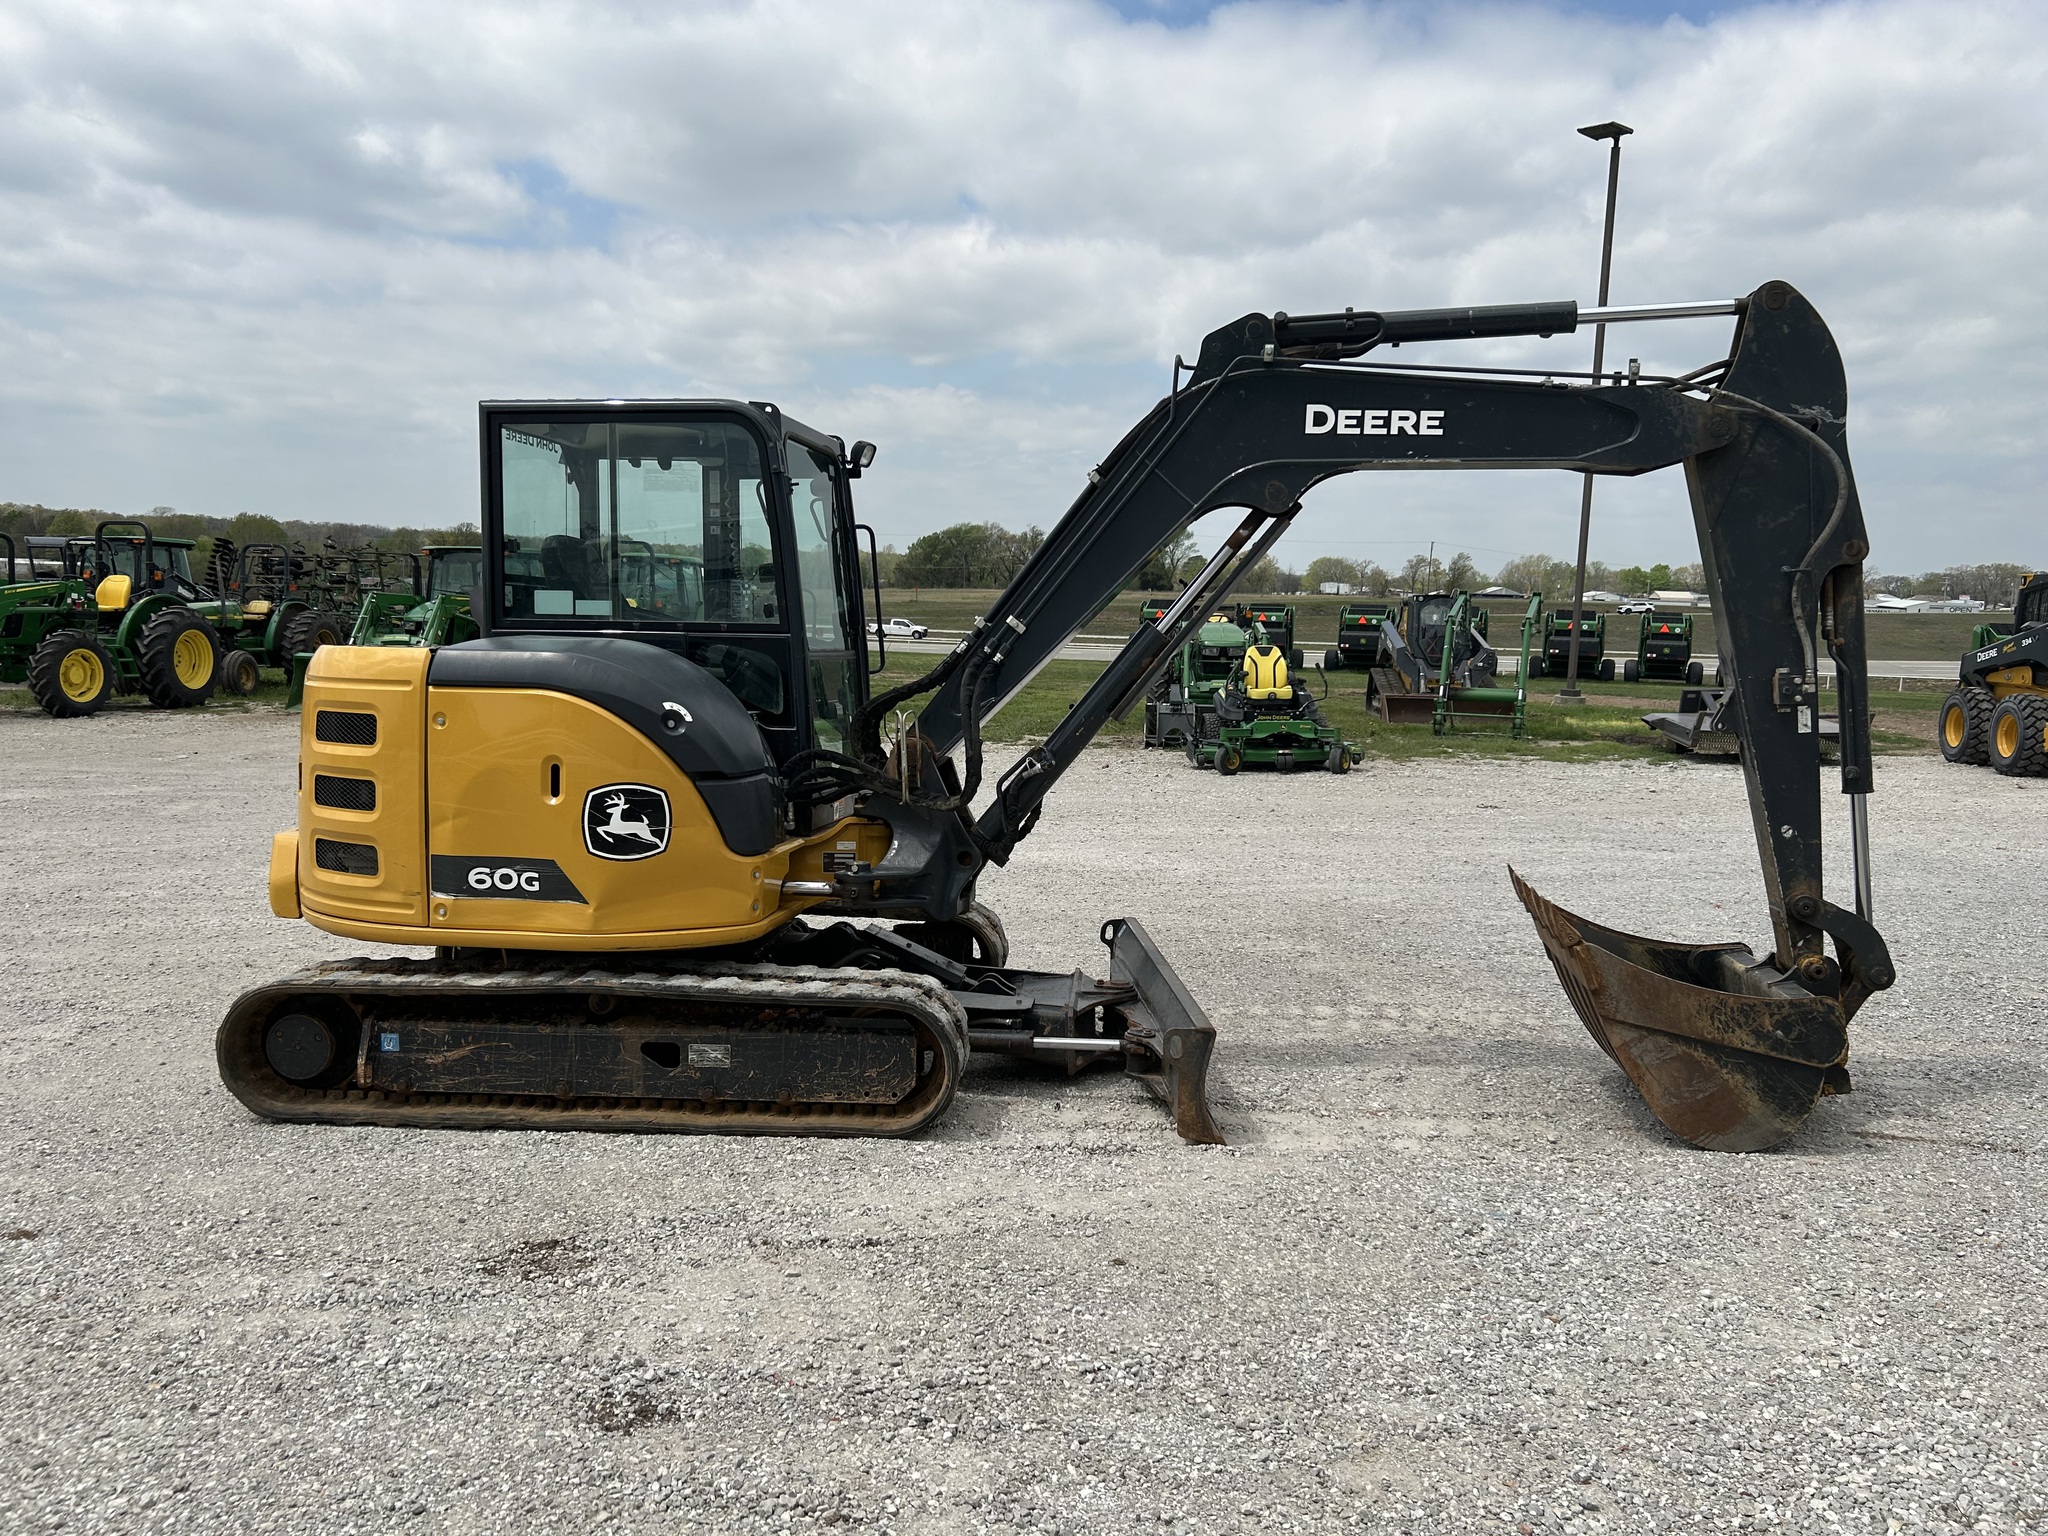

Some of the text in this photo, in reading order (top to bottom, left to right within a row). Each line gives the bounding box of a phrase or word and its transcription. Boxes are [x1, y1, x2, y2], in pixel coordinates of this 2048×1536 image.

[1304, 403, 1445, 436] DEERE
[1976, 648, 1998, 663] DEERE
[467, 867, 540, 892] 60G
